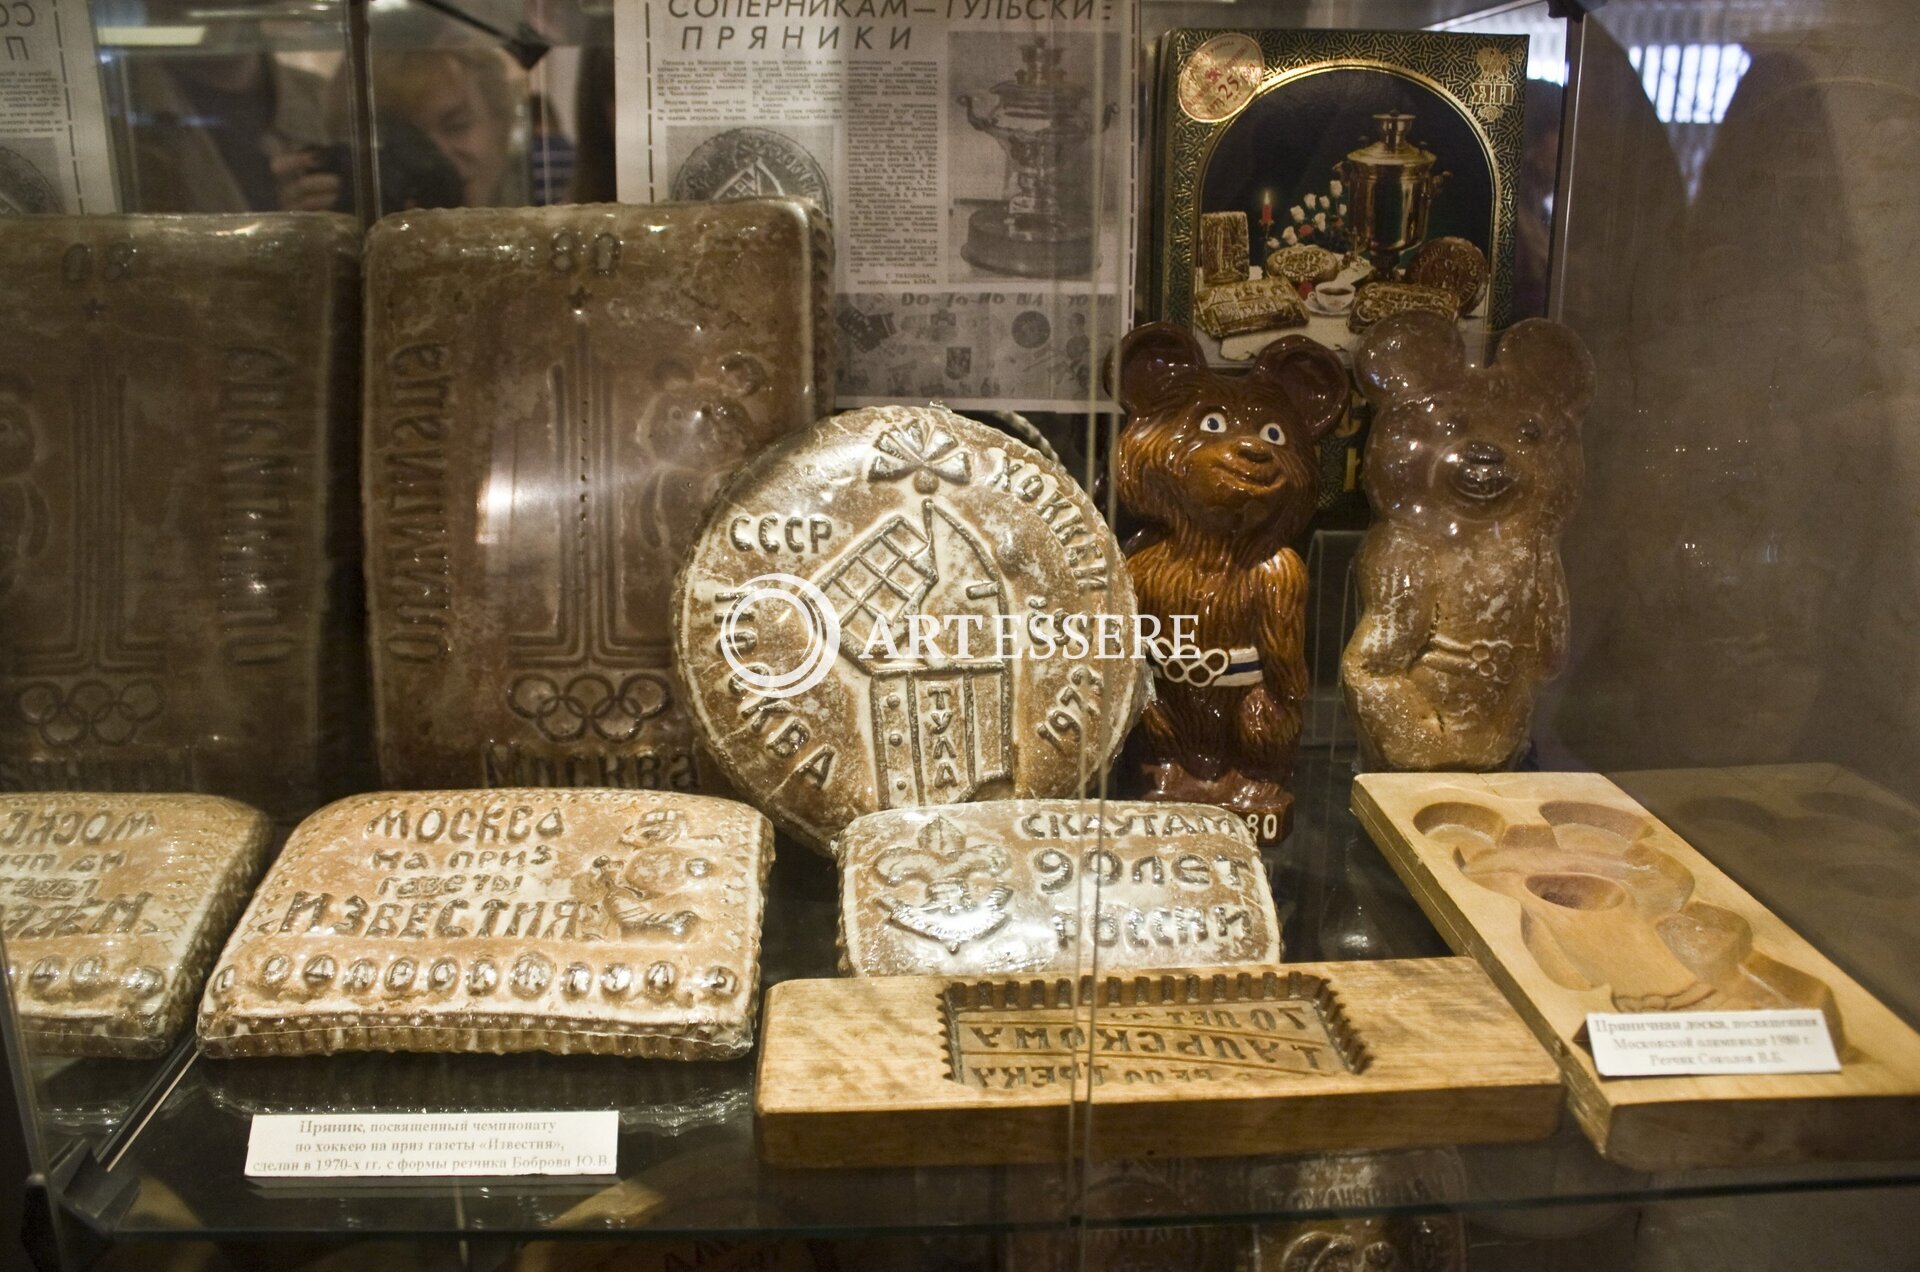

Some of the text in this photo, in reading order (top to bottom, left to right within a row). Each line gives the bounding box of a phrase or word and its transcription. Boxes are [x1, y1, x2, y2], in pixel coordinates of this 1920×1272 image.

[682, 26, 911, 50] ПРЯНИКИ
[1218, 75, 1239, 100] 25
[729, 514, 833, 553] СССР
[927, 686, 957, 788] ТУЛА
[1021, 812, 1240, 839] СКАУТАМ
[1247, 813, 1277, 840] 80
[278, 890, 582, 939] ИЗВЕСТИЯ
[1613, 1036, 1694, 1050] Московской
[300, 1119, 366, 1136] Пряник,
[473, 1121, 557, 1134] чемпионату
[296, 1143, 311, 1153] по
[315, 1142, 367, 1152] хоккею
[371, 1142, 386, 1151] на
[391, 1141, 423, 1154] приз
[428, 1141, 475, 1151] газеты
[253, 1161, 299, 1172] сделан
[304, 1162, 311, 1171] в
[316, 1159, 360, 1171] 1970-х
[387, 1162, 394, 1170] с
[397, 1158, 447, 1172] формы
[452, 1160, 507, 1171] резчика
[512, 1156, 571, 1171] Боброва
